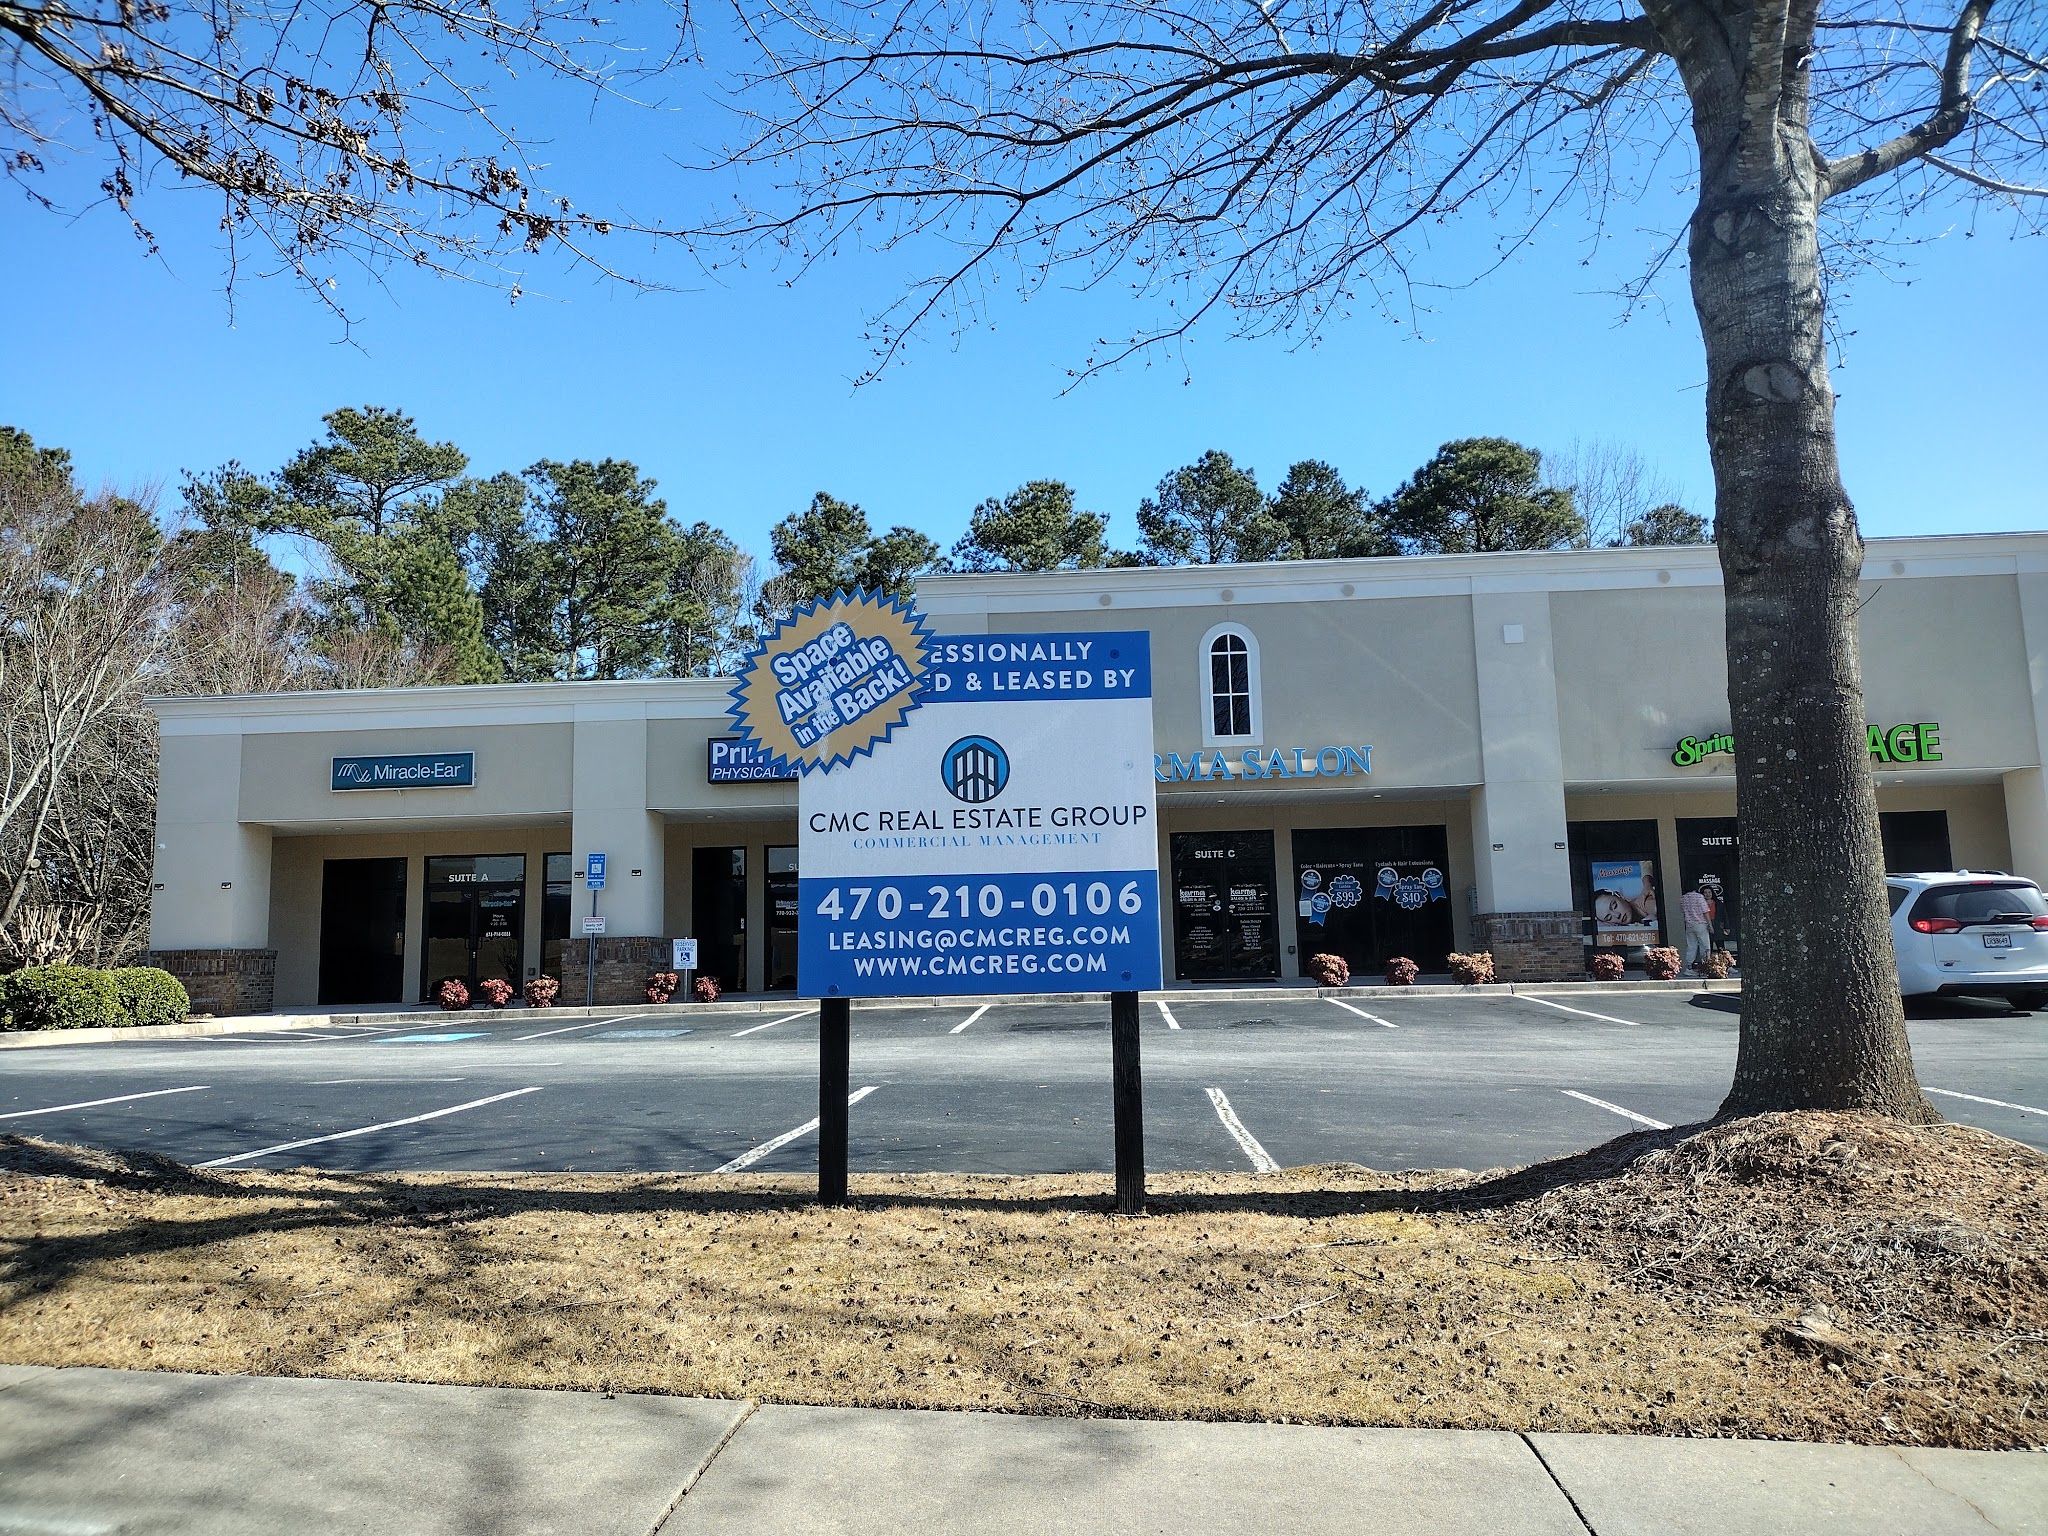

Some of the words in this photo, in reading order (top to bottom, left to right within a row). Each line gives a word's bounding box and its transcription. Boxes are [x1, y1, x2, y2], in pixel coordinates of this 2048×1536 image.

[774, 626, 851, 684] Space
[930, 641, 1093, 664] ESSIONALLY
[779, 639, 889, 721] Available
[965, 672, 983, 691] &
[992, 670, 1093, 691] LEASED
[1103, 668, 1136, 688] BY
[795, 725, 815, 745] in
[812, 710, 840, 735] the
[834, 659, 911, 721] Back!
[712, 743, 763, 764] Pri
[1672, 733, 1735, 767] Sprin
[1867, 723, 1942, 762] AGE
[712, 766, 779, 779] PHYSICAL
[1153, 750, 1235, 783] RMA
[1241, 745, 1374, 781] SALON
[809, 811, 870, 833] CMC
[878, 810, 944, 831] REAL
[952, 808, 1042, 829] ESTATE
[1050, 805, 1147, 827] GROUP
[853, 835, 971, 849] COMMERCIAL
[979, 832, 1102, 846] MANAGEMENT
[1702, 836, 1732, 846] SUITE
[1194, 850, 1224, 859] SUITE
[1227, 849, 1236, 858] C
[448, 873, 477, 882] SUITE
[481, 873, 489, 881] A
[816, 881, 1143, 921] 470-210-0106
[1336, 891, 1355, 902] $99
[1402, 892, 1420, 903] $40
[829, 925, 1131, 952] LEASING@CMCREG.COM
[854, 953, 1107, 977] WWW.CMCREG.COM
